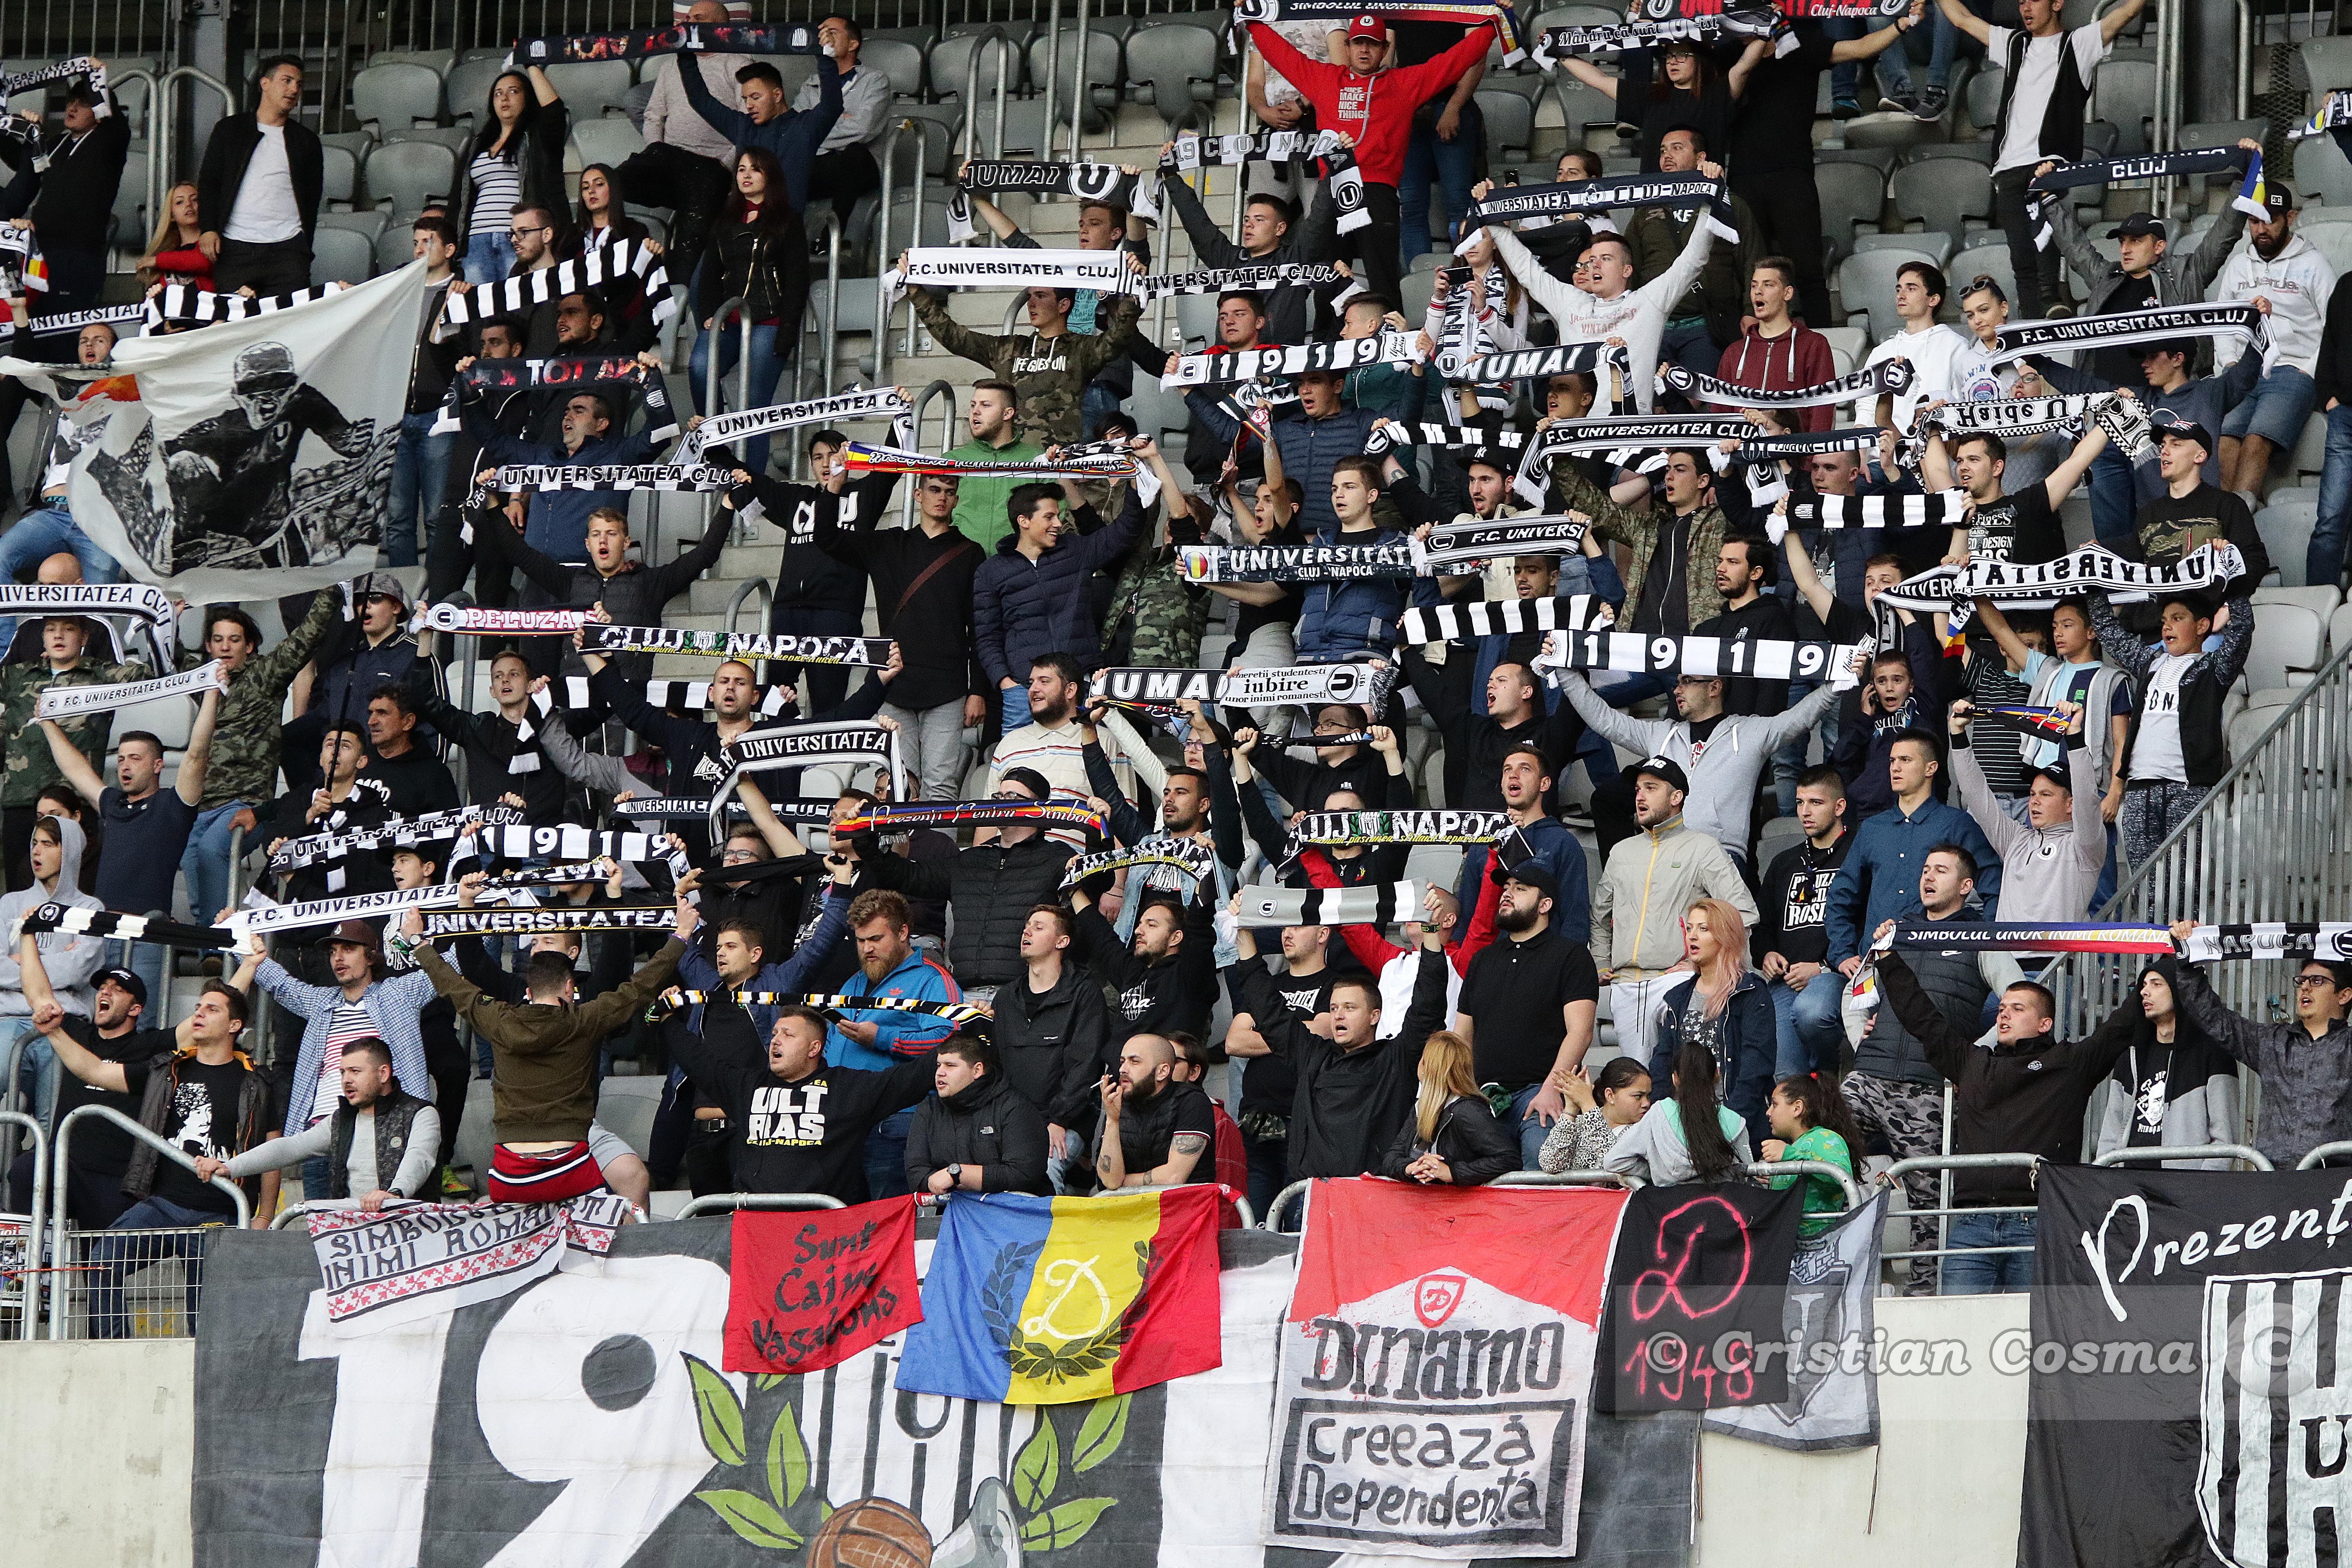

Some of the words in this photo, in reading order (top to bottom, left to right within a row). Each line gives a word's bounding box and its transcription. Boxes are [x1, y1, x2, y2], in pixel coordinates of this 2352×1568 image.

[1810, 4, 1877, 18] Cluj-Napoca
[1338, 101, 1357, 109] NICE
[1339, 92, 1363, 101] MAKE
[1338, 110, 1369, 119] THINGS
[1204, 137, 1268, 157] CLUJ
[2112, 159, 2167, 178] CLUJ
[1485, 191, 1571, 214] UNIVERSITATEA
[1613, 182, 1712, 204] CLUJ-NAPOCA
[1077, 265, 1117, 279] CLUJ
[1142, 266, 1280, 292] NIVERSITATEA
[1286, 264, 1341, 282] CLUJ
[2020, 329, 2053, 344] F.C.
[2057, 312, 2196, 339] UNIVERSITATEA
[2200, 310, 2249, 324] CLUJ
[1456, 345, 1584, 381] NUMAI
[715, 394, 878, 434] UNIVERSITATEA
[1546, 430, 1574, 445] F.C.
[1578, 423, 1712, 439] UNIVERSITATEA
[1716, 424, 1759, 440] CLU
[503, 466, 683, 487] UNIVERSITATEA
[689, 466, 742, 487] CLU
[1471, 530, 1501, 543] F.C.
[1507, 524, 1585, 540] UNIVERSI
[1982, 536, 2014, 549] DESIGN
[1229, 545, 1412, 573] UNIVERSITAT
[1298, 567, 1321, 578] CLUJ
[1331, 565, 1374, 578] NAPOCA
[0, 586, 132, 604] IVERSITATEA
[464, 607, 577, 631] PELUZA
[601, 626, 685, 648] CLUJ
[726, 633, 870, 664] NAPOCA
[1271, 667, 1327, 678] studentesti
[64, 695, 82, 707] F.C.
[85, 683, 162, 704] UNIVERSITATEA
[165, 675, 192, 687] CLUJ
[1243, 678, 1309, 694] iubire
[1250, 693, 1276, 702] inimi
[1277, 690, 1327, 701] romanesti
[741, 732, 887, 759] UNIVERSITATEA
[1025, 800, 1092, 824] Simbol
[1300, 812, 1350, 839] LUJ
[1391, 812, 1506, 840] NAPOC
[247, 910, 283, 927] F.C.
[291, 882, 458, 917] UNIVERSITATEA
[750, 1084, 829, 1114] ULT
[747, 1113, 826, 1140] RAS
[793, 1220, 878, 1265] Sunt
[2081, 1179, 2352, 1323] Prezenț
[324, 1241, 418, 1291] INIMI
